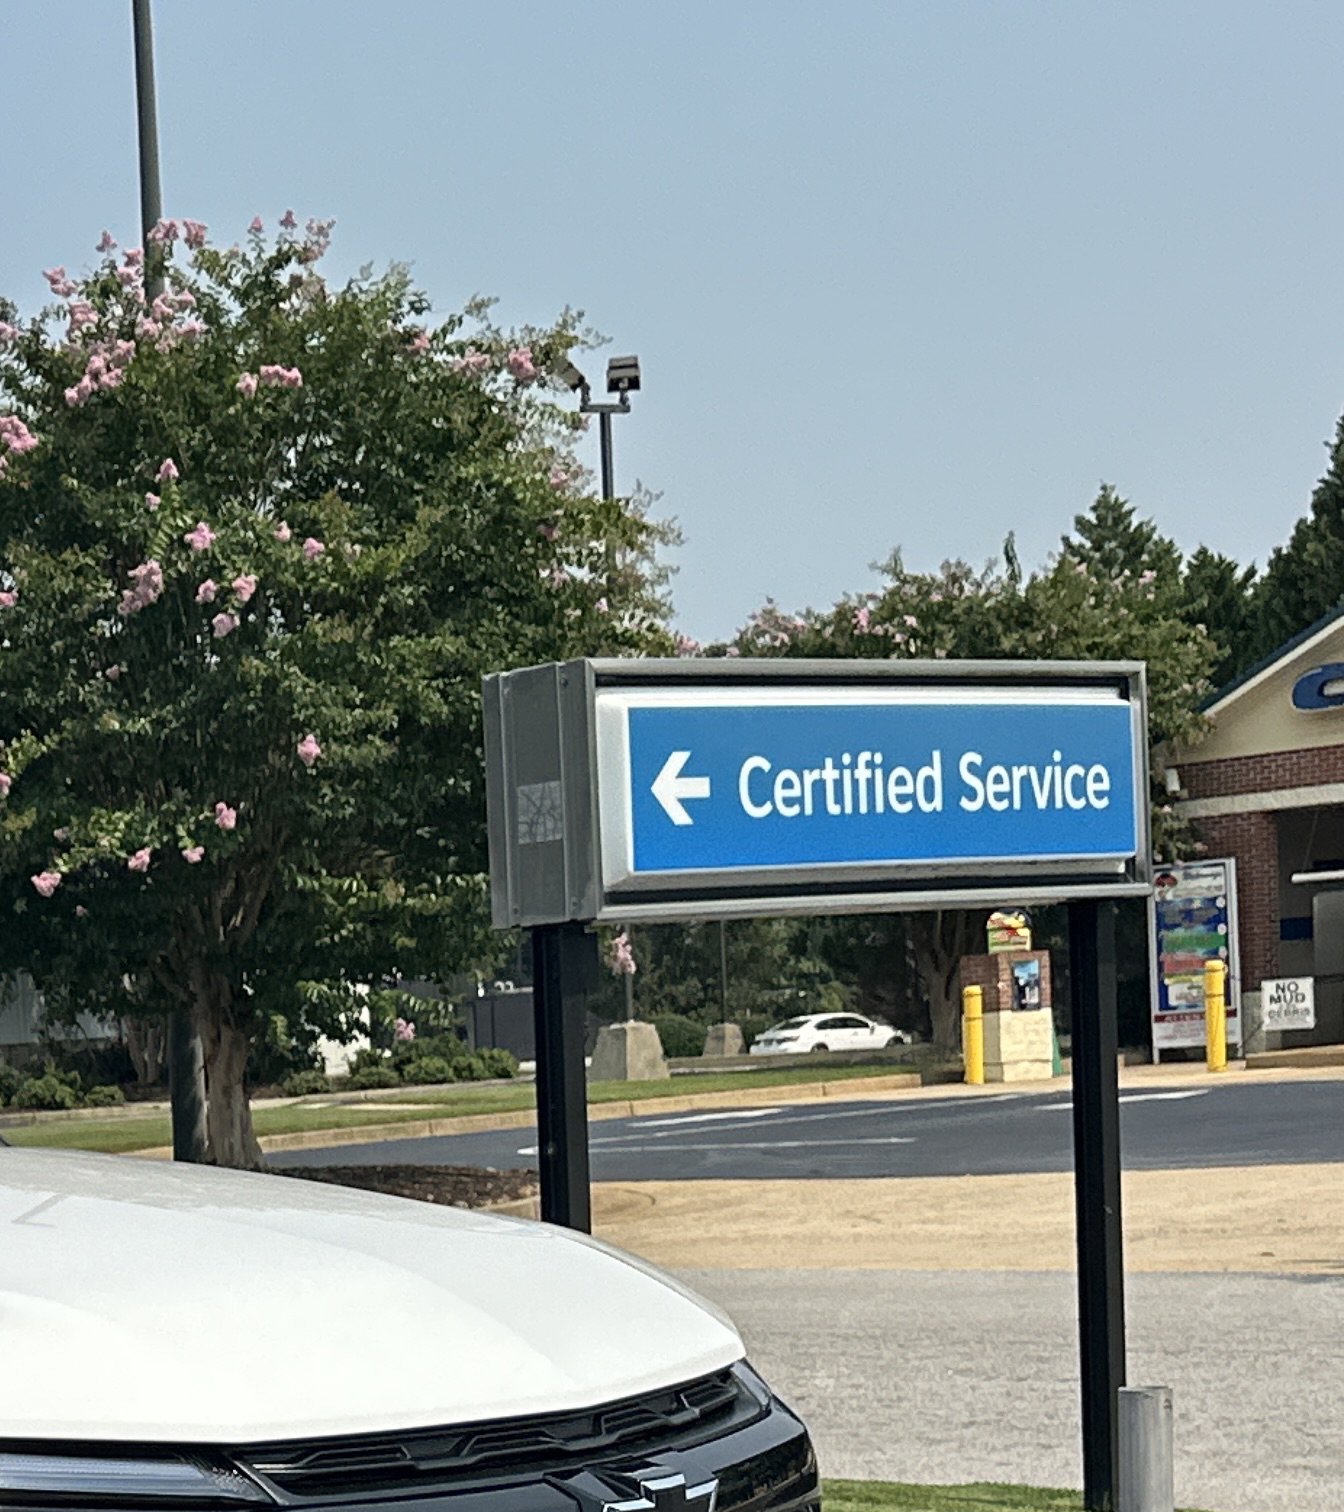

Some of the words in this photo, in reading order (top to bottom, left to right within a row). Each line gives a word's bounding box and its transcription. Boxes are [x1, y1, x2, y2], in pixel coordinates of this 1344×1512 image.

[738, 749, 943, 819] Certified
[958, 749, 1111, 813] Service
[1275, 981, 1299, 994] NO
[1269, 992, 1306, 1005] MUD
